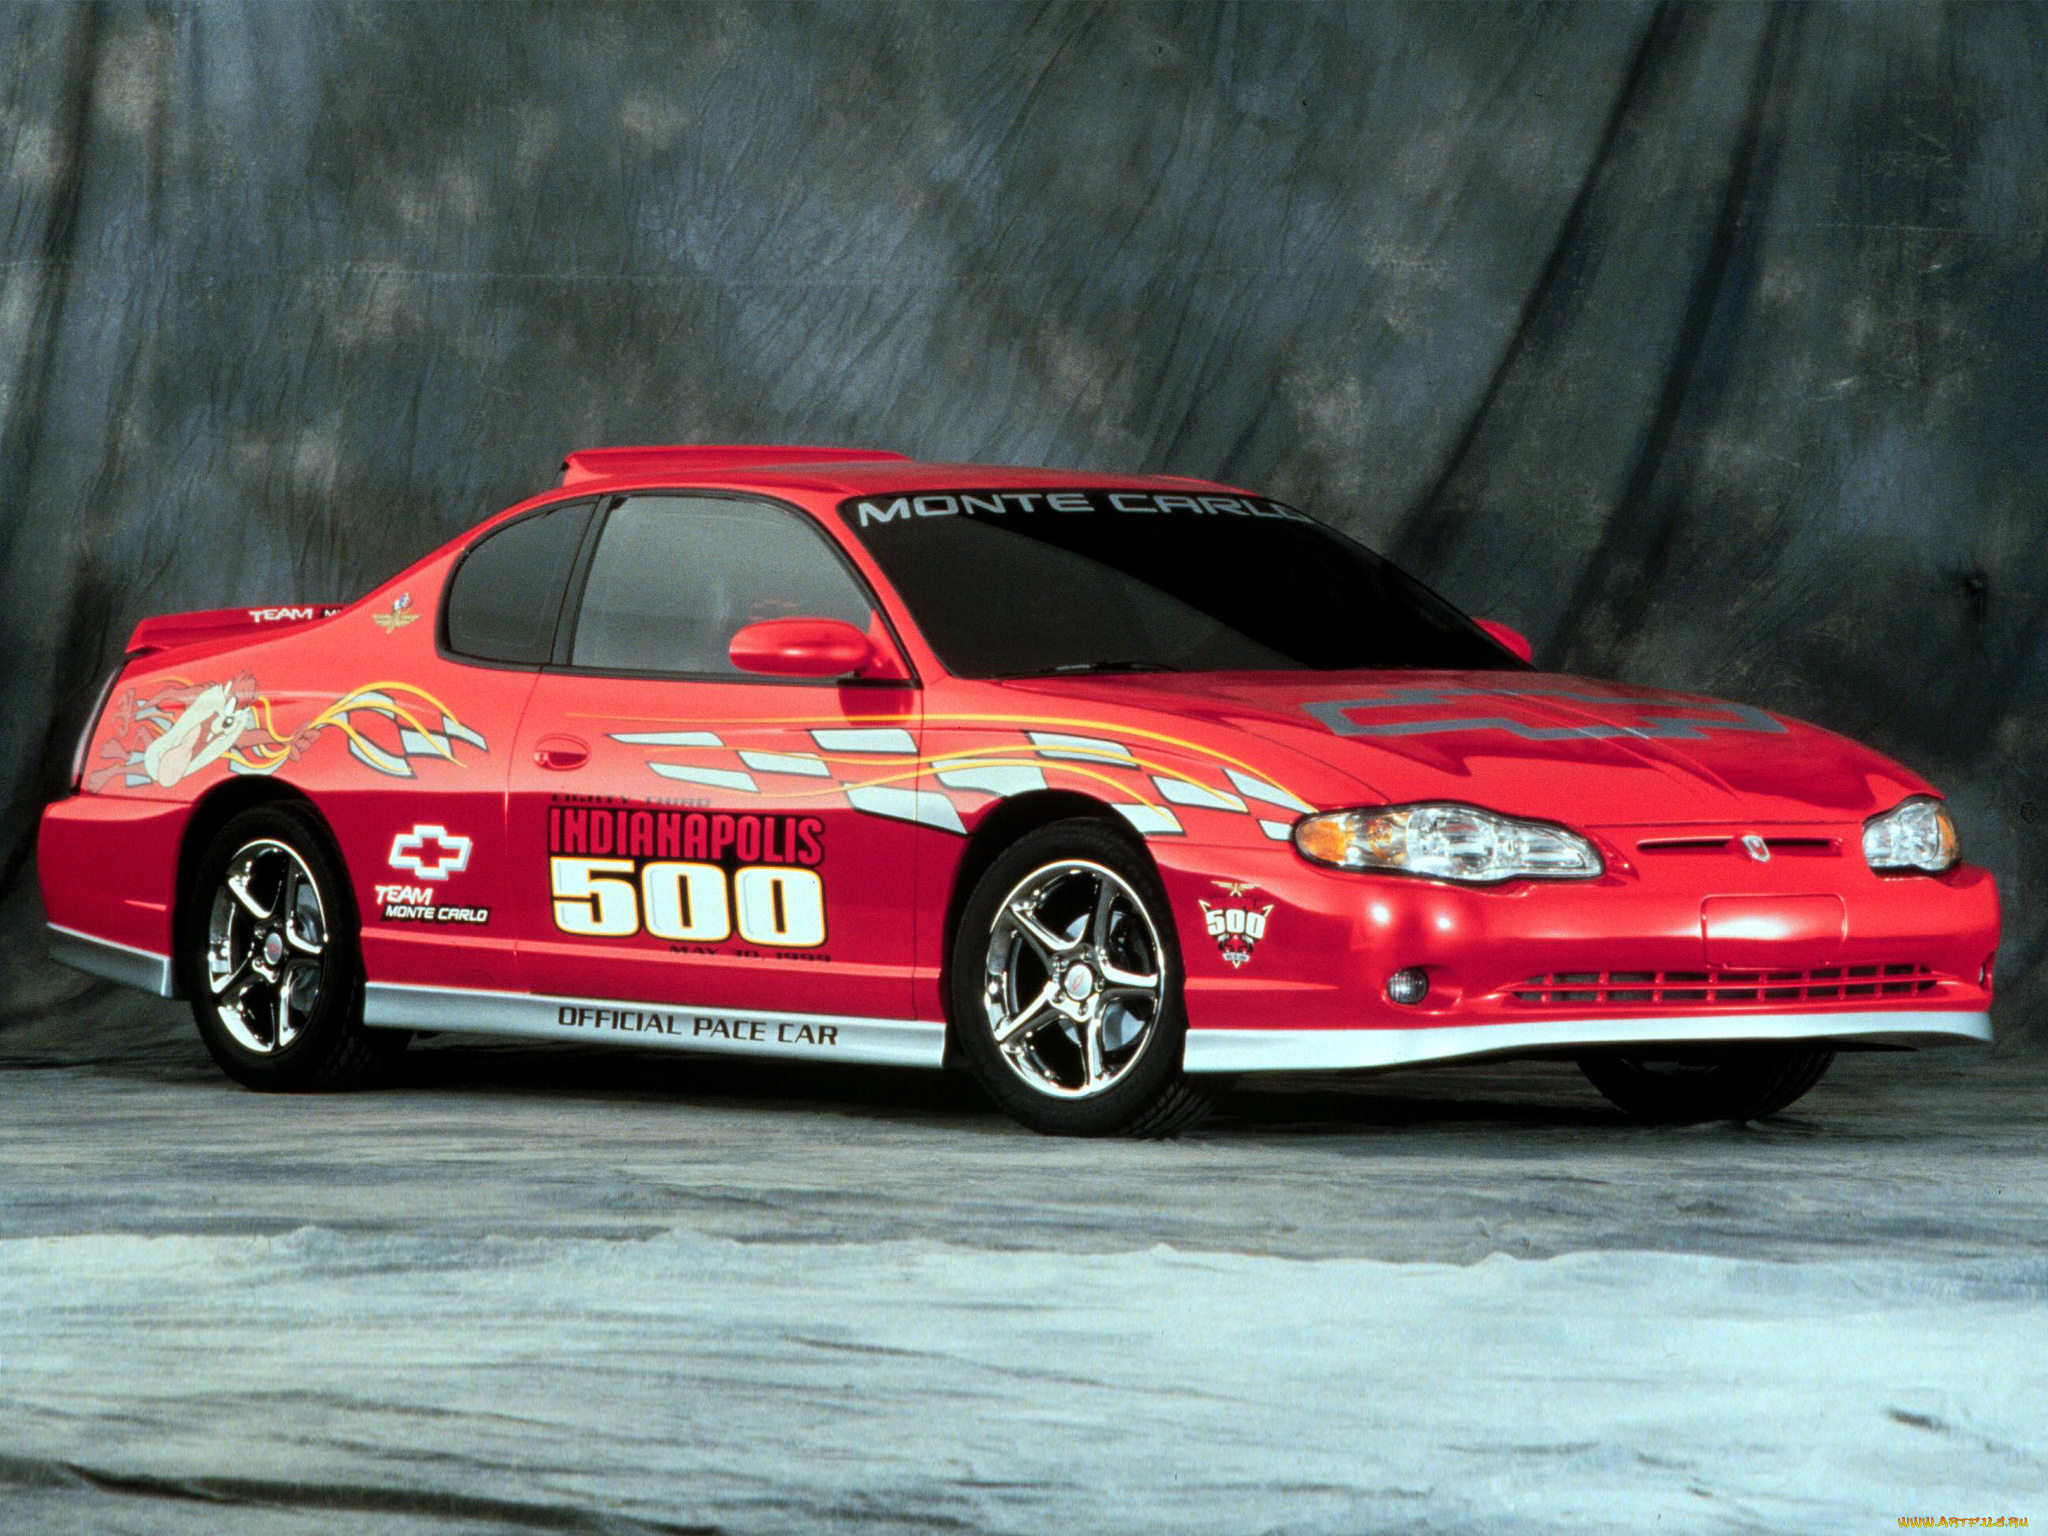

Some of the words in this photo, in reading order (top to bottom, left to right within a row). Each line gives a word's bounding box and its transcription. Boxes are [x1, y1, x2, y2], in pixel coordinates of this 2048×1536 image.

[858, 492, 1095, 527] MONTE
[248, 607, 313, 623] TEAM
[550, 807, 825, 865] INDIANAPOLIS
[374, 884, 434, 906] TEAM
[549, 856, 828, 948] 500
[385, 904, 436, 920] MONTE
[437, 907, 489, 922] CARLO
[1205, 908, 1266, 939] 500
[668, 944, 719, 956] MAY
[557, 1005, 682, 1036] OFFICIAL
[692, 1016, 768, 1042] PACE
[777, 1022, 839, 1047] CAR
